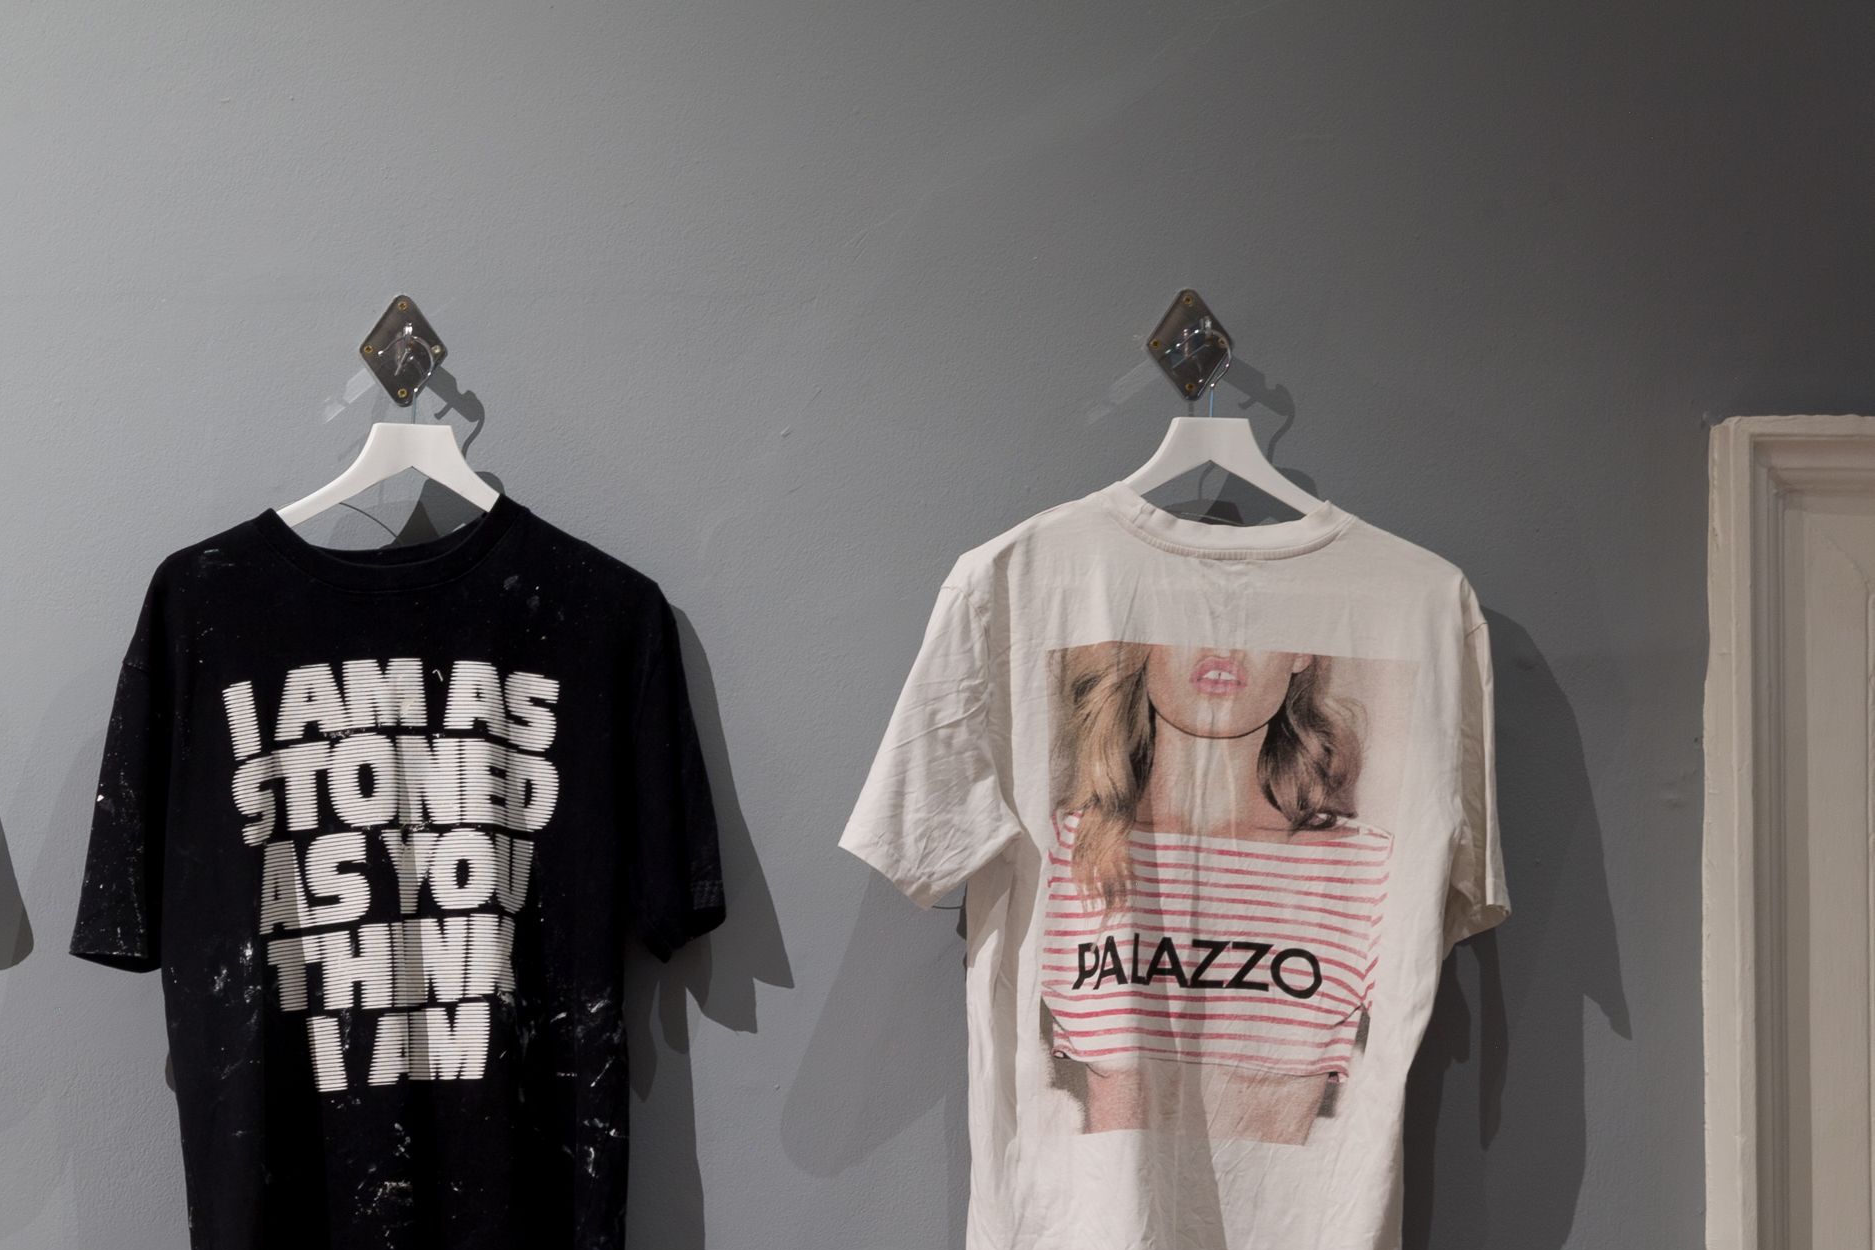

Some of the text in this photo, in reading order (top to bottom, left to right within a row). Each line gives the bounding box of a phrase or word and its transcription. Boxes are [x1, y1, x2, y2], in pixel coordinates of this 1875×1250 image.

[222, 658, 560, 760] I AM AS
[231, 733, 560, 847] STONED
[260, 828, 534, 936] AS YOU
[267, 913, 516, 1012] THINK
[1071, 932, 1323, 1000] PALAZZO
[308, 1002, 491, 1093] I AM
